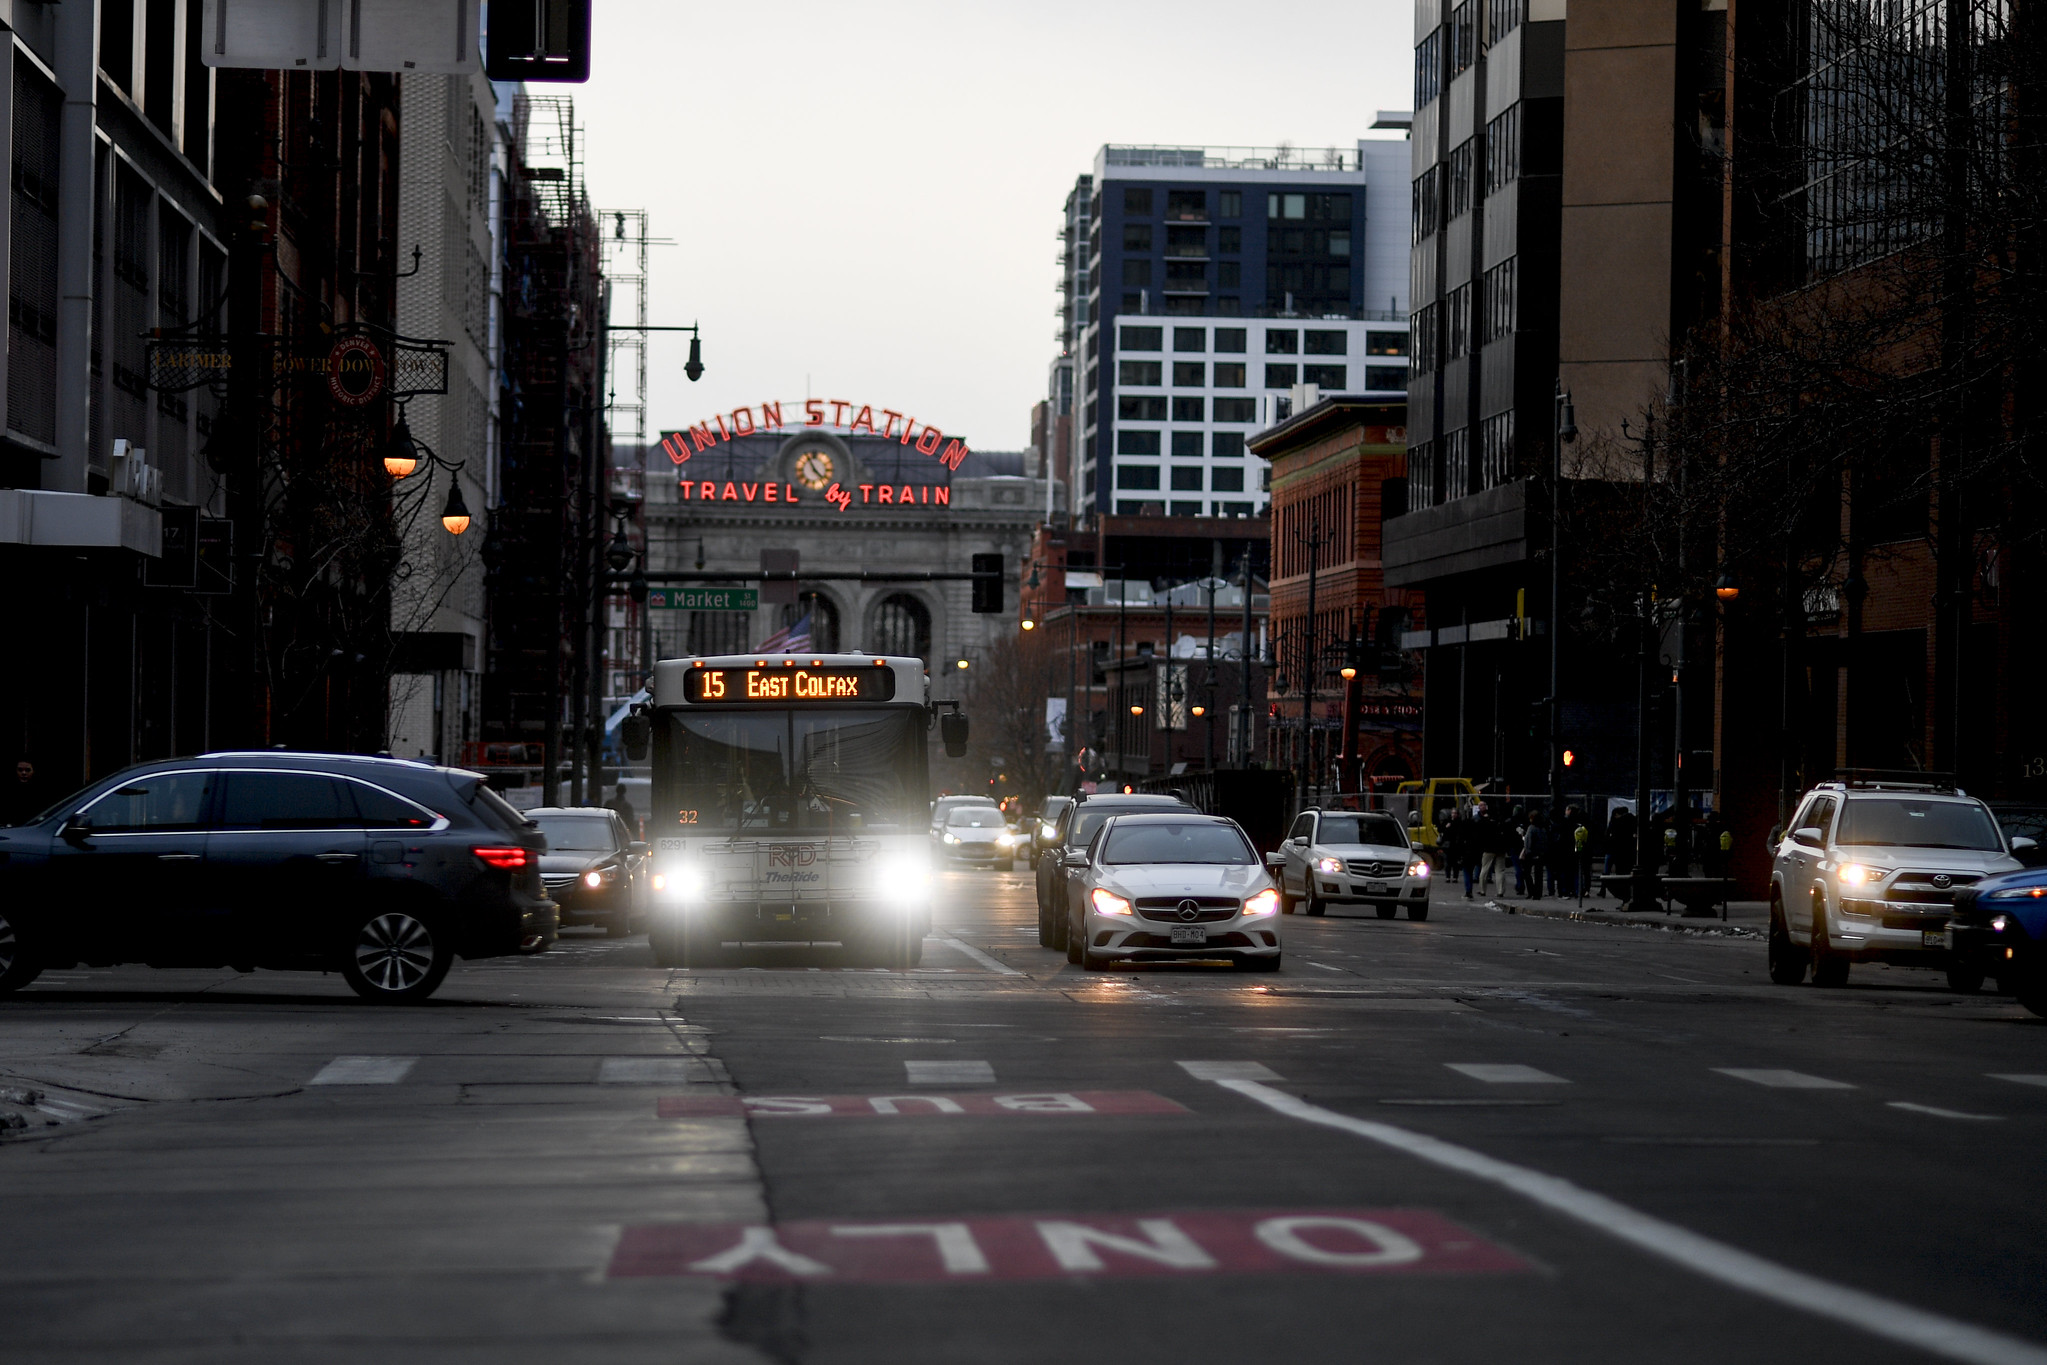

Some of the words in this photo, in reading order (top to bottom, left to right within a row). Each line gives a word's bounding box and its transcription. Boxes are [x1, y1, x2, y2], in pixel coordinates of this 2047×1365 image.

[339, 339, 370, 350] DENVER
[155, 353, 233, 368] LARIMER
[272, 357, 333, 372] LOWER
[329, 376, 355, 405] HISTORIC
[358, 375, 382, 405] DISTRICT
[661, 400, 784, 466] UNION
[805, 399, 970, 471] STATION
[680, 481, 799, 503] TRAVEL
[825, 483, 852, 512] by
[860, 484, 950, 506] TRAIN
[674, 591, 730, 607] Market
[703, 671, 725, 698] 15
[748, 671, 788, 698] EAST
[795, 671, 858, 697] COLFAX
[2023, 757, 2047, 778] 13
[679, 810, 698, 824] 32
[661, 839, 687, 850] 6291
[766, 871, 820, 883] TheRide
[740, 1092, 1096, 1115] BUS
[690, 1217, 1423, 1274] ONLY
